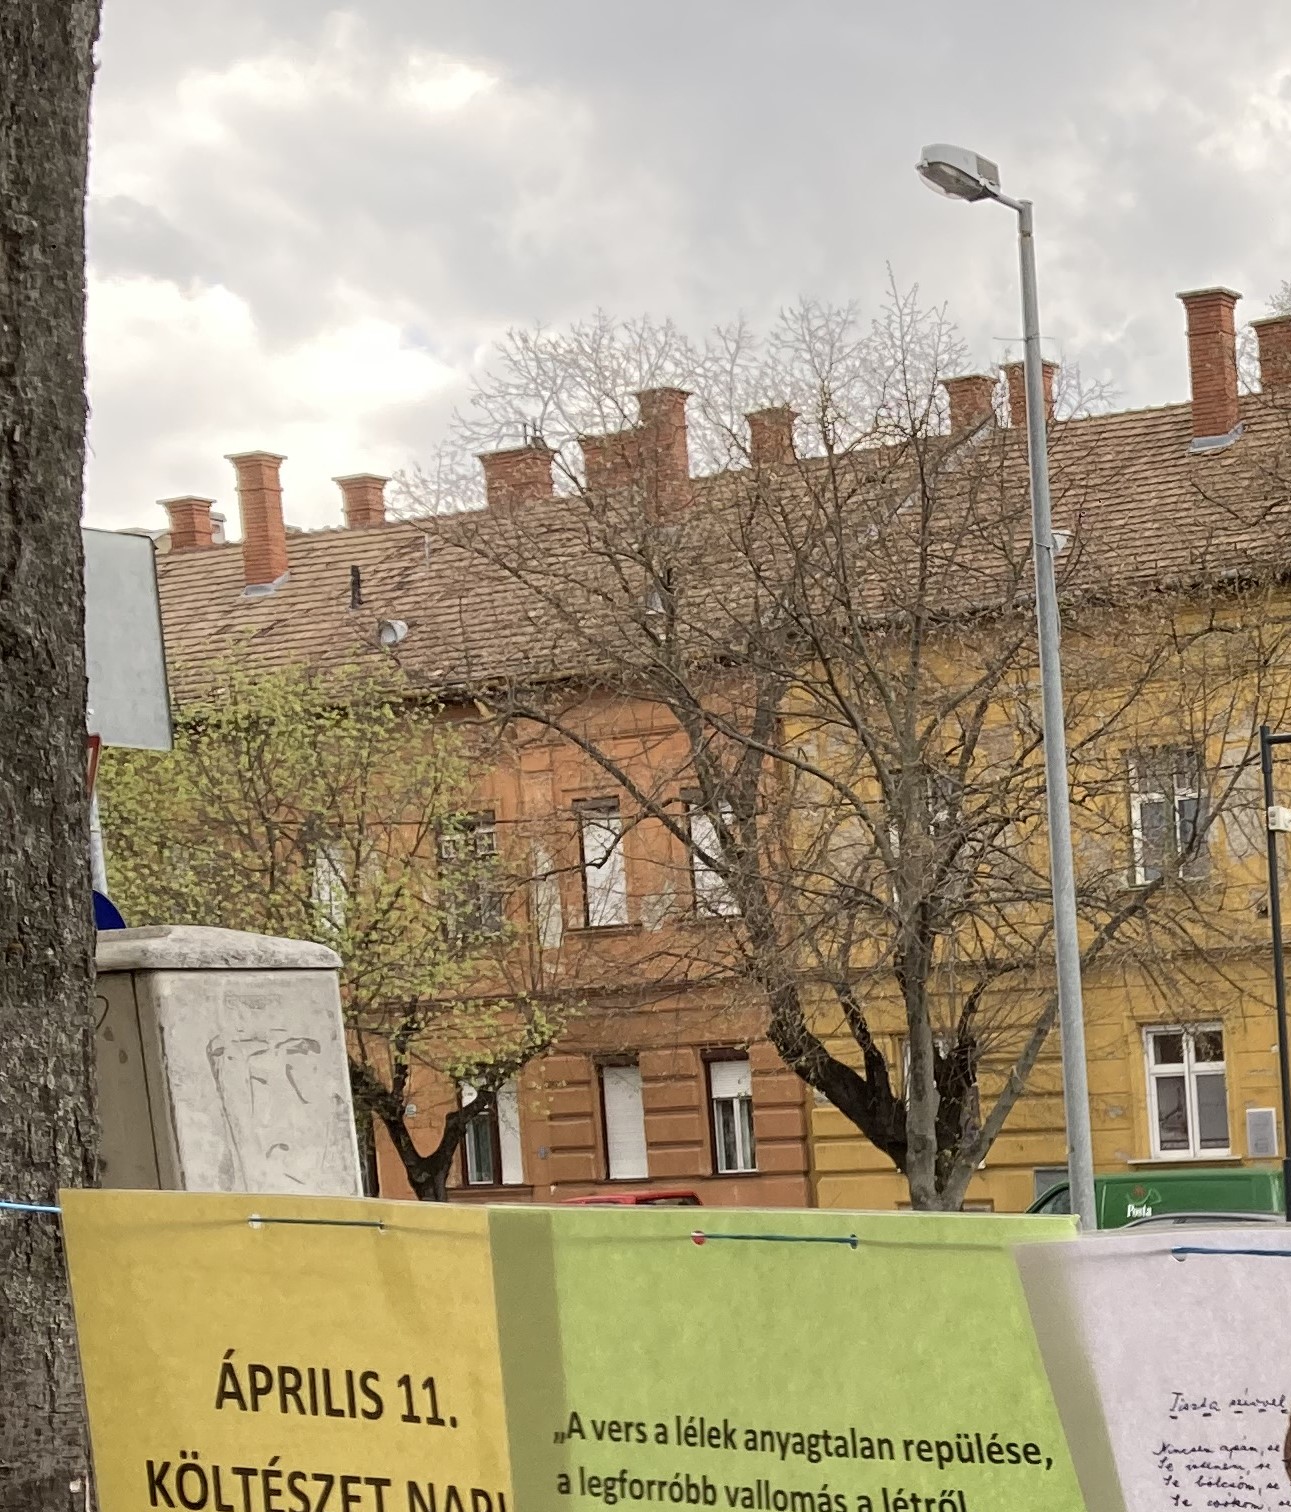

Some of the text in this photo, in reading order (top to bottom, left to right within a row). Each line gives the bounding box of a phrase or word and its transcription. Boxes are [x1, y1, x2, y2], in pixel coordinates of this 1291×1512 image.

[1126, 1203, 1152, 1218] Posta
[215, 1349, 458, 1428] ÁPRILIS 11.
[590, 1419, 648, 1445] vers
[654, 1422, 669, 1446] a
[675, 1415, 738, 1451] lélek
[743, 1427, 896, 1464] anyagtalan
[902, 1432, 1054, 1471] repülése,
[556, 1472, 573, 1496] a
[578, 1465, 718, 1507] legforróbb
